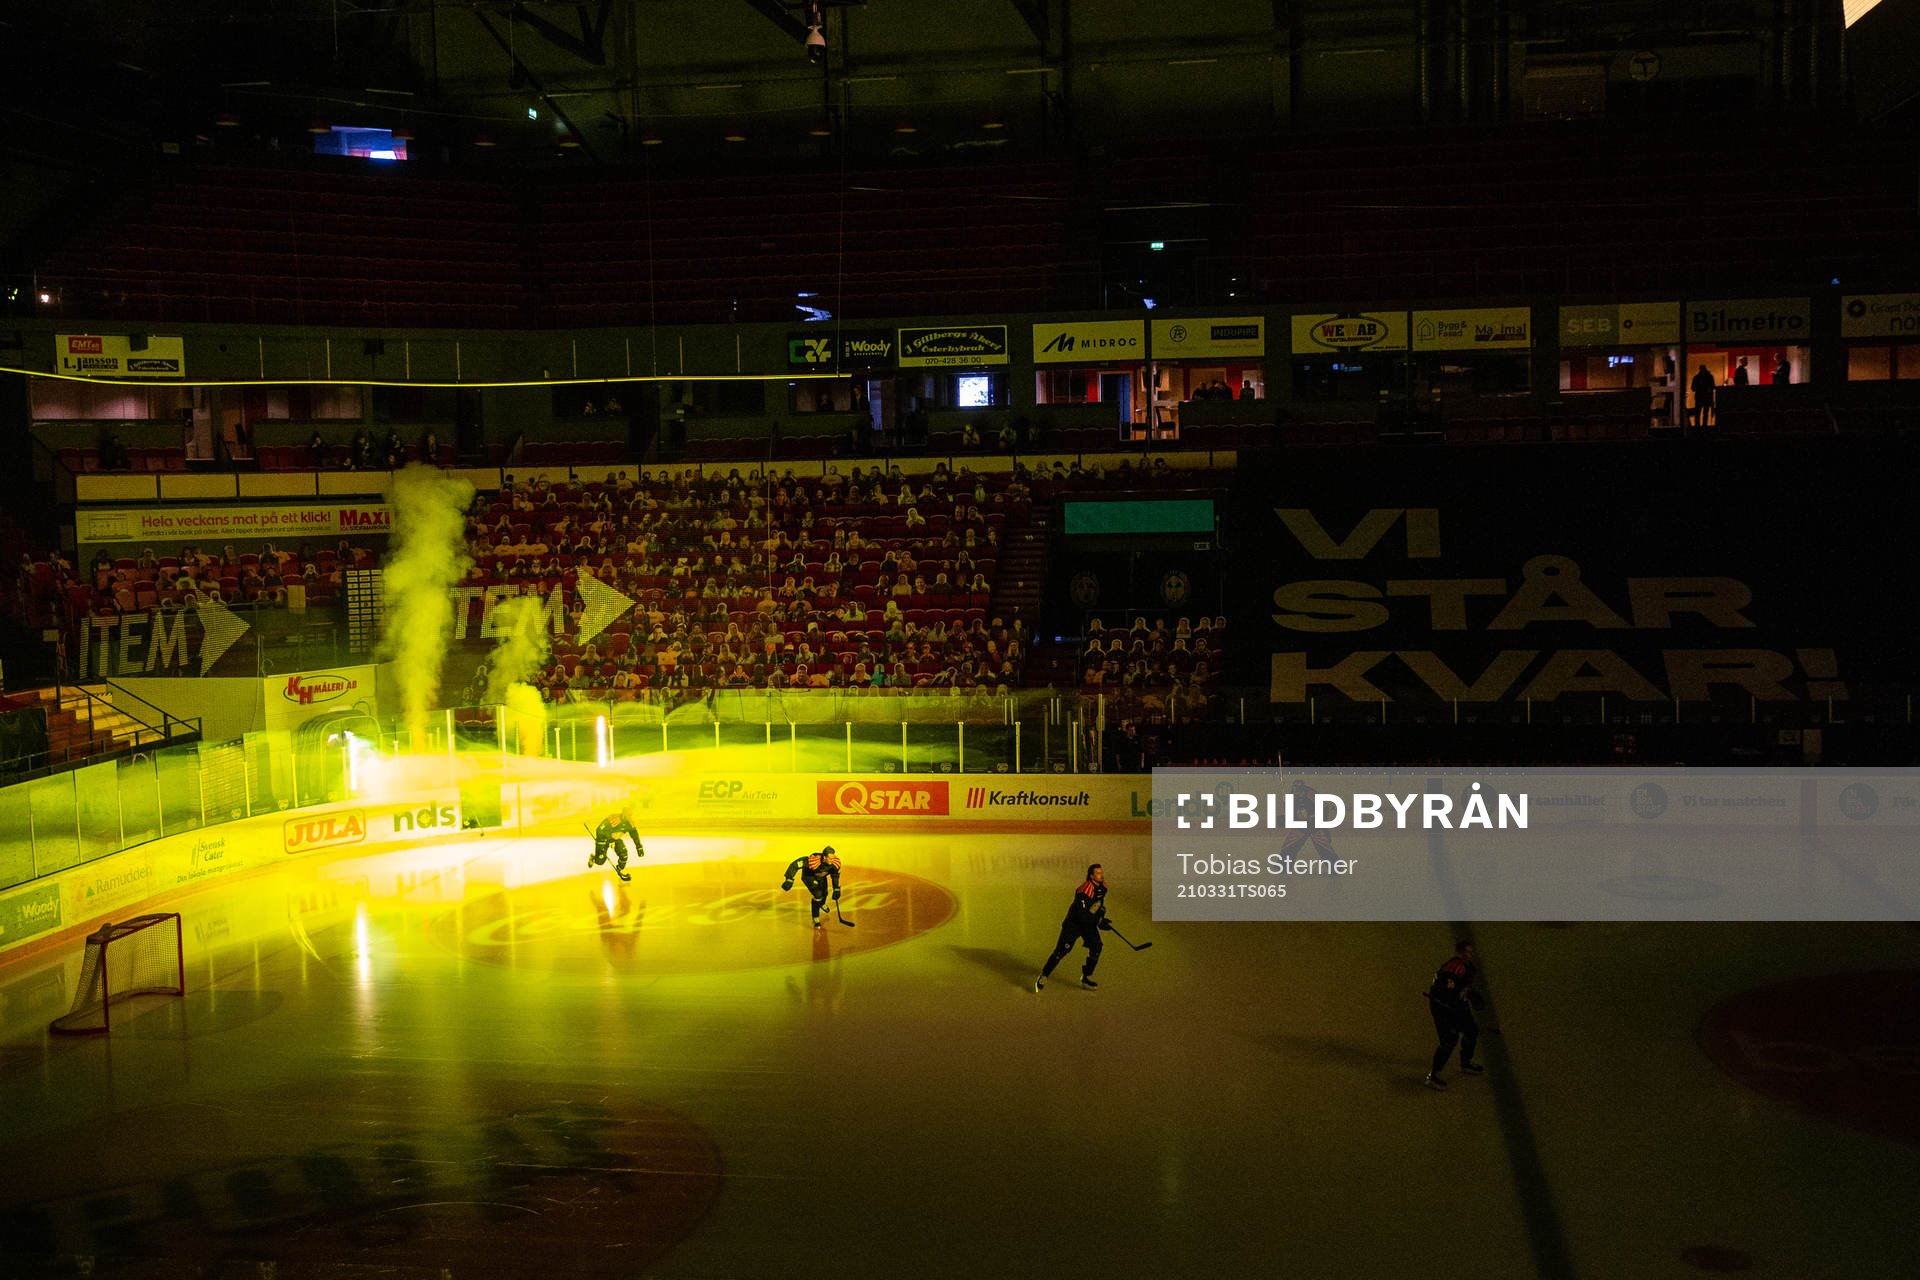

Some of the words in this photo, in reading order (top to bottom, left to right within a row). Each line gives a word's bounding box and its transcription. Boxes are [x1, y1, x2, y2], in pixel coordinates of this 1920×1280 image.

[1693, 310, 1803, 332] Bilmetro
[850, 339, 891, 357] Woody
[1081, 337, 1138, 348] MIDROC
[142, 515, 173, 528] Hela
[176, 514, 230, 527] veckans
[232, 514, 258, 525] mat
[261, 511, 278, 526] på
[281, 512, 298, 524] ett
[300, 511, 331, 523] klick!
[1273, 508, 1442, 559] VI
[1271, 553, 1757, 633] STÅR
[1269, 648, 1850, 703] KVAR!
[314, 682, 344, 694] MÅLERI
[346, 681, 357, 690] AB
[699, 780, 743, 800] ECP
[741, 790, 778, 801] AirTech
[988, 789, 1090, 807] Kraftkonsult
[1722, 796, 1787, 807] matchen
[393, 799, 457, 832] nds
[287, 814, 363, 847] JULA
[96, 866, 153, 894] Ramudden
[22, 896, 60, 918] Woody
